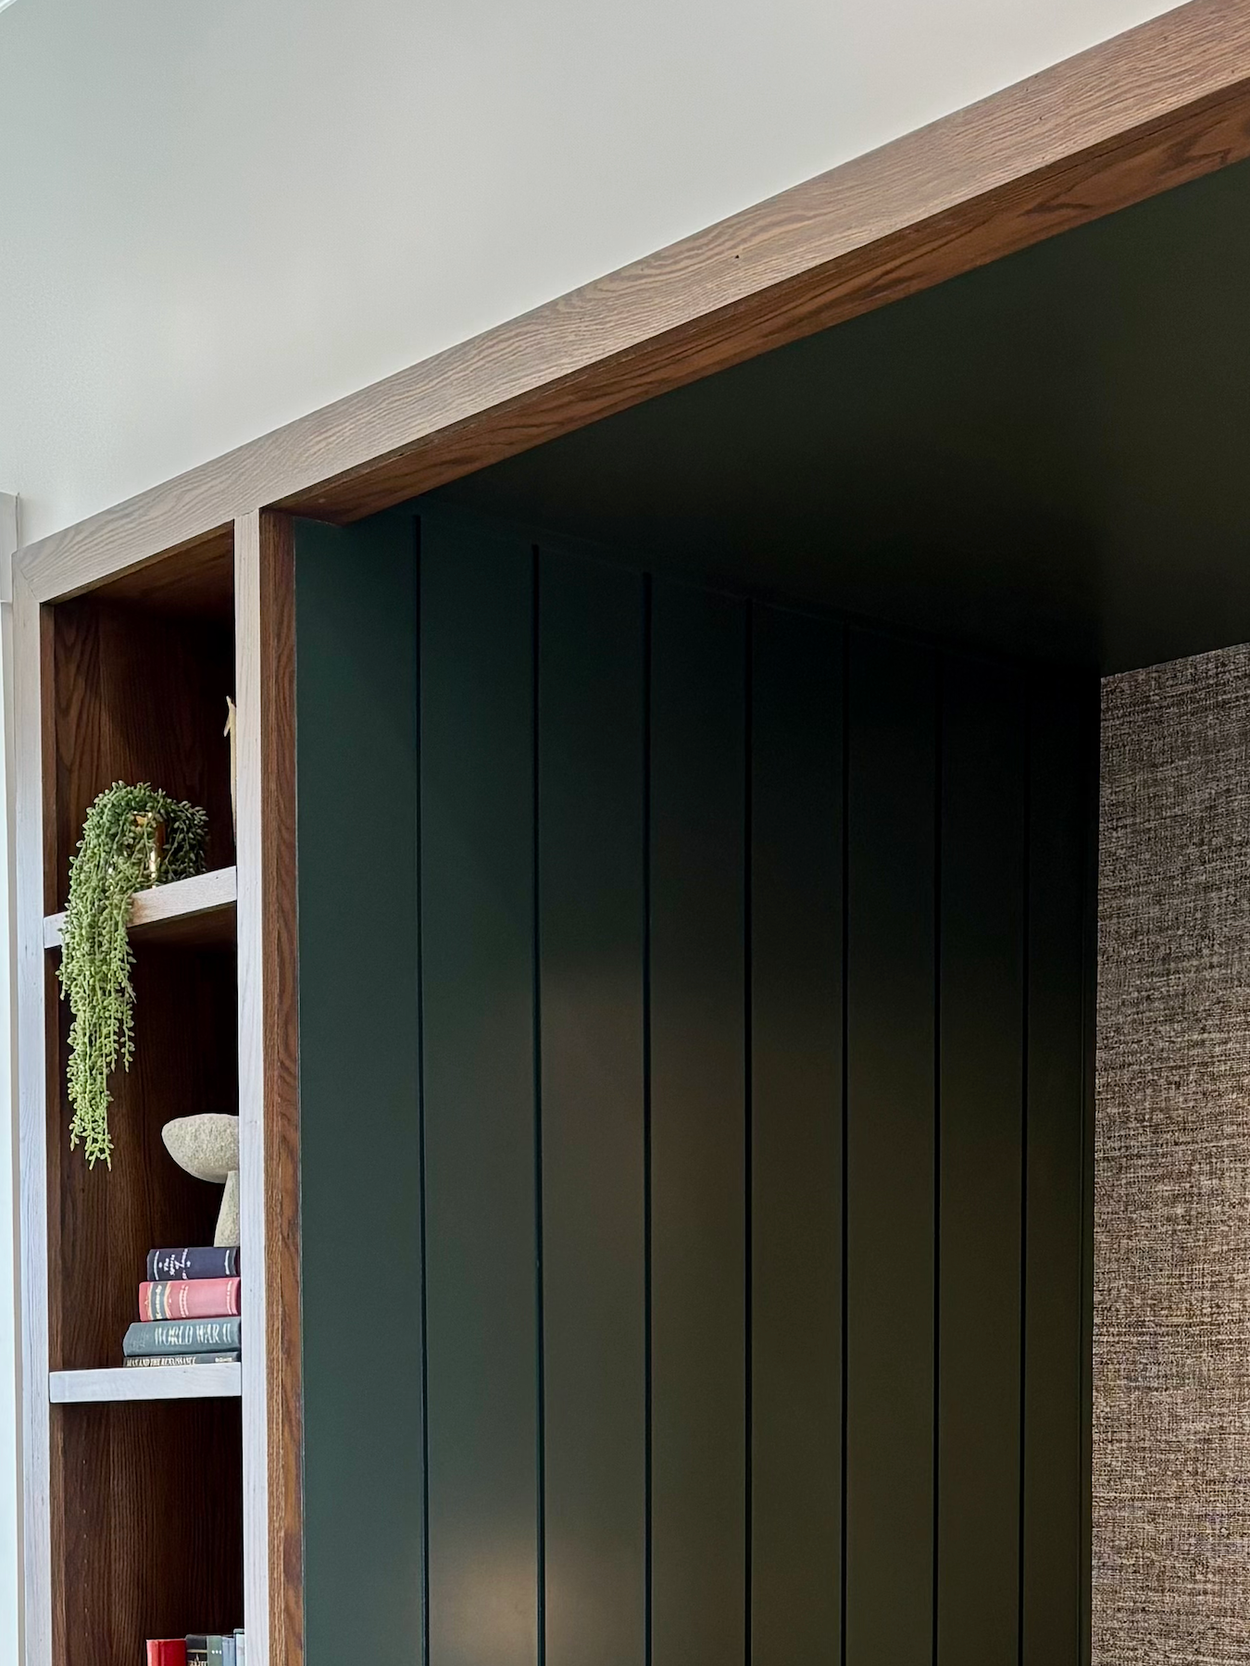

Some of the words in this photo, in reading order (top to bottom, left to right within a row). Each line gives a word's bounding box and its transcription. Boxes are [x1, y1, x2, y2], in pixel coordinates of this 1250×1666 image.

[155, 1325, 194, 1346] WORLD
[196, 1323, 220, 1344] WAR
[222, 1323, 232, 1343] II
